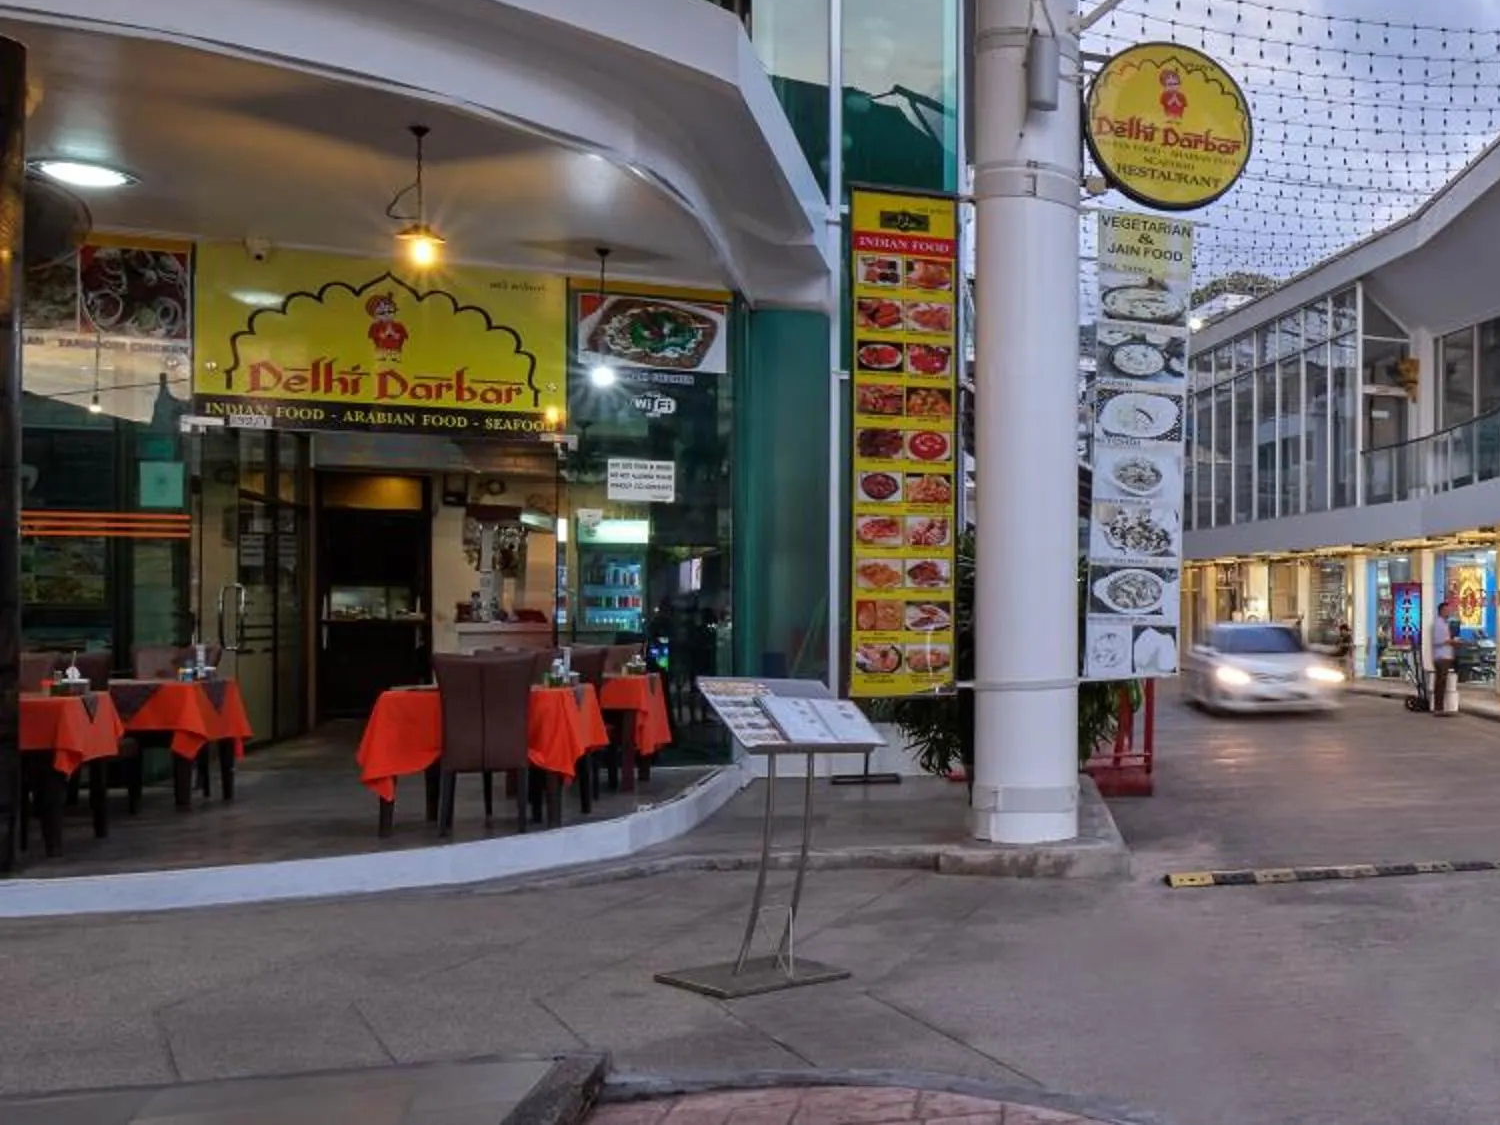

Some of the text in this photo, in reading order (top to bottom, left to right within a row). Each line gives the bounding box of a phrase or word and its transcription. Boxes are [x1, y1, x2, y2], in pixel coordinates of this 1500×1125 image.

[1097, 116, 1242, 155] Delhi Darbar
[1116, 163, 1223, 188] RESTAURANT
[1101, 215, 1192, 237] VEGETARIAN
[859, 236, 949, 253] INDIAN FOOD
[1138, 233, 1154, 245] &
[1108, 242, 1183, 262] JAIN FOOD
[246, 356, 524, 404] Delhi Darbar
[205, 402, 268, 416] INDIAN
[276, 406, 325, 420] FOOD
[343, 410, 415, 425] ARABIAN
[423, 414, 468, 428] FOOD
